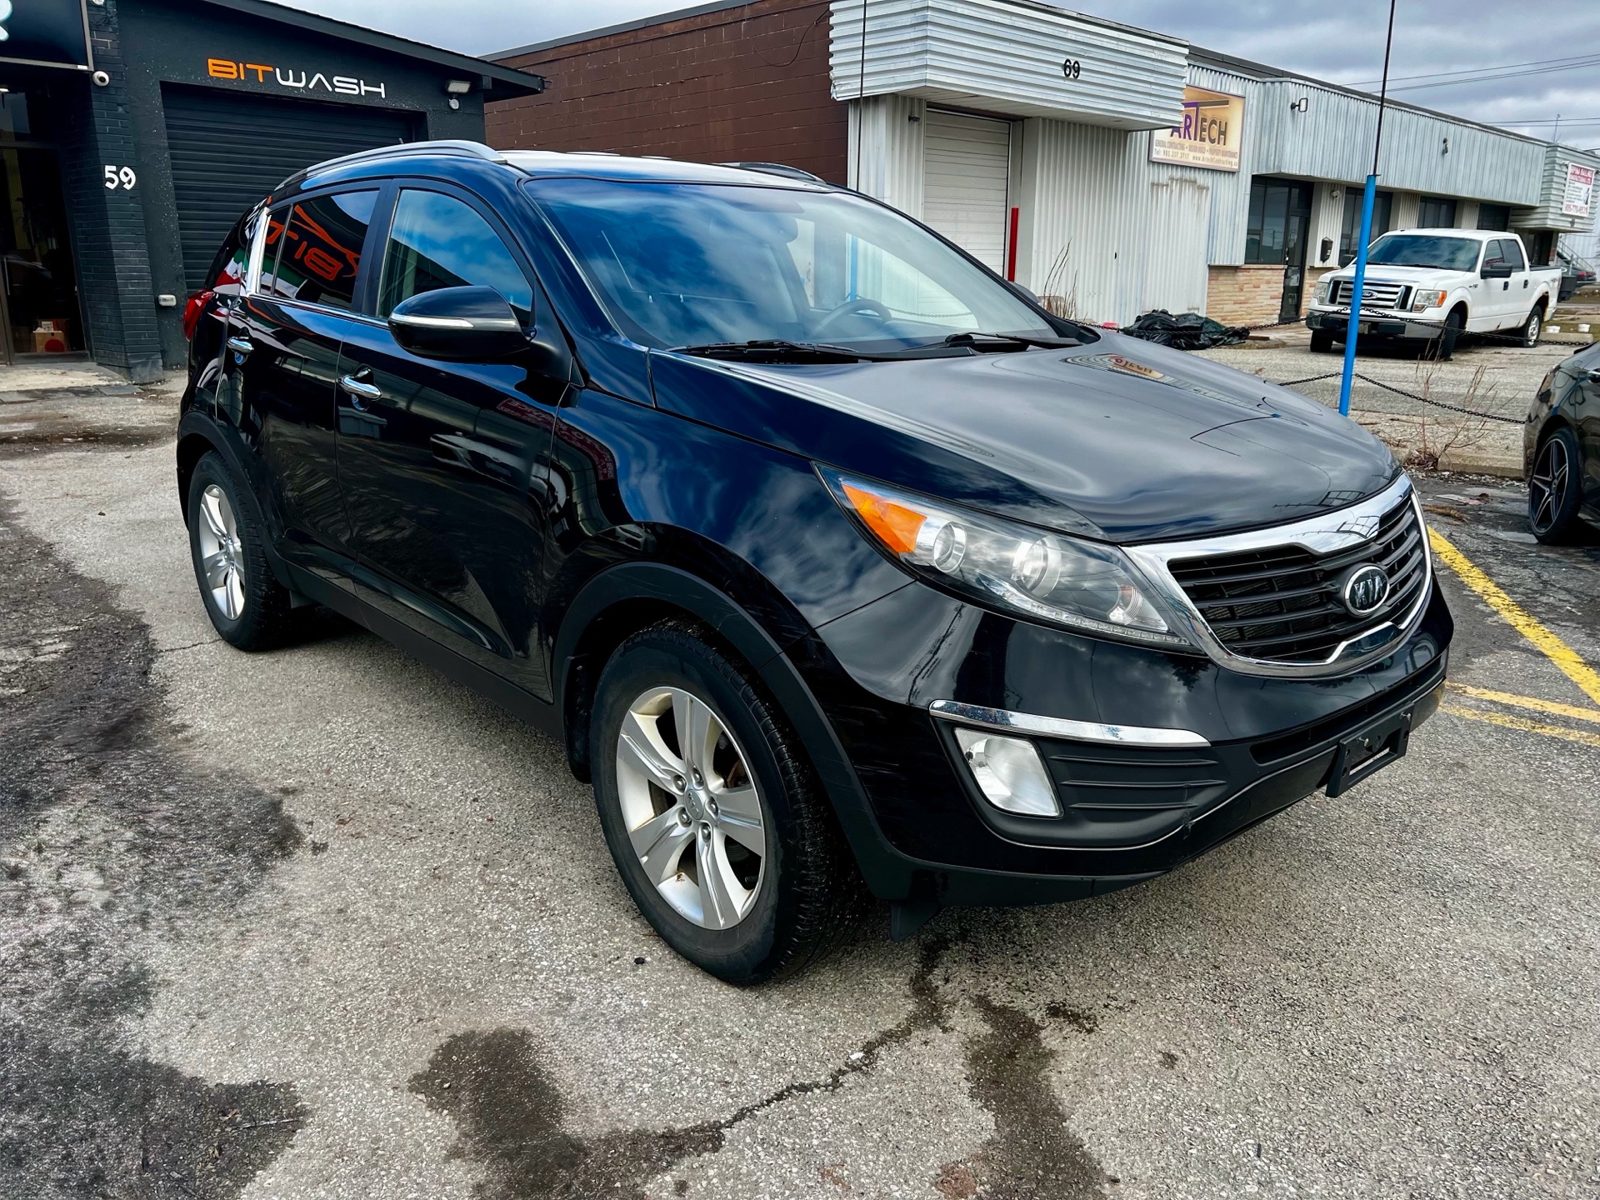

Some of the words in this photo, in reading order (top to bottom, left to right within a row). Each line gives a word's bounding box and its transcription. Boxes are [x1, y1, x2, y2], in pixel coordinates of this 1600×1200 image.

[208, 59, 386, 98] BITWASH
[1063, 59, 1081, 79] 69
[104, 165, 136, 190] 59
[1354, 577, 1383, 608] KIA
